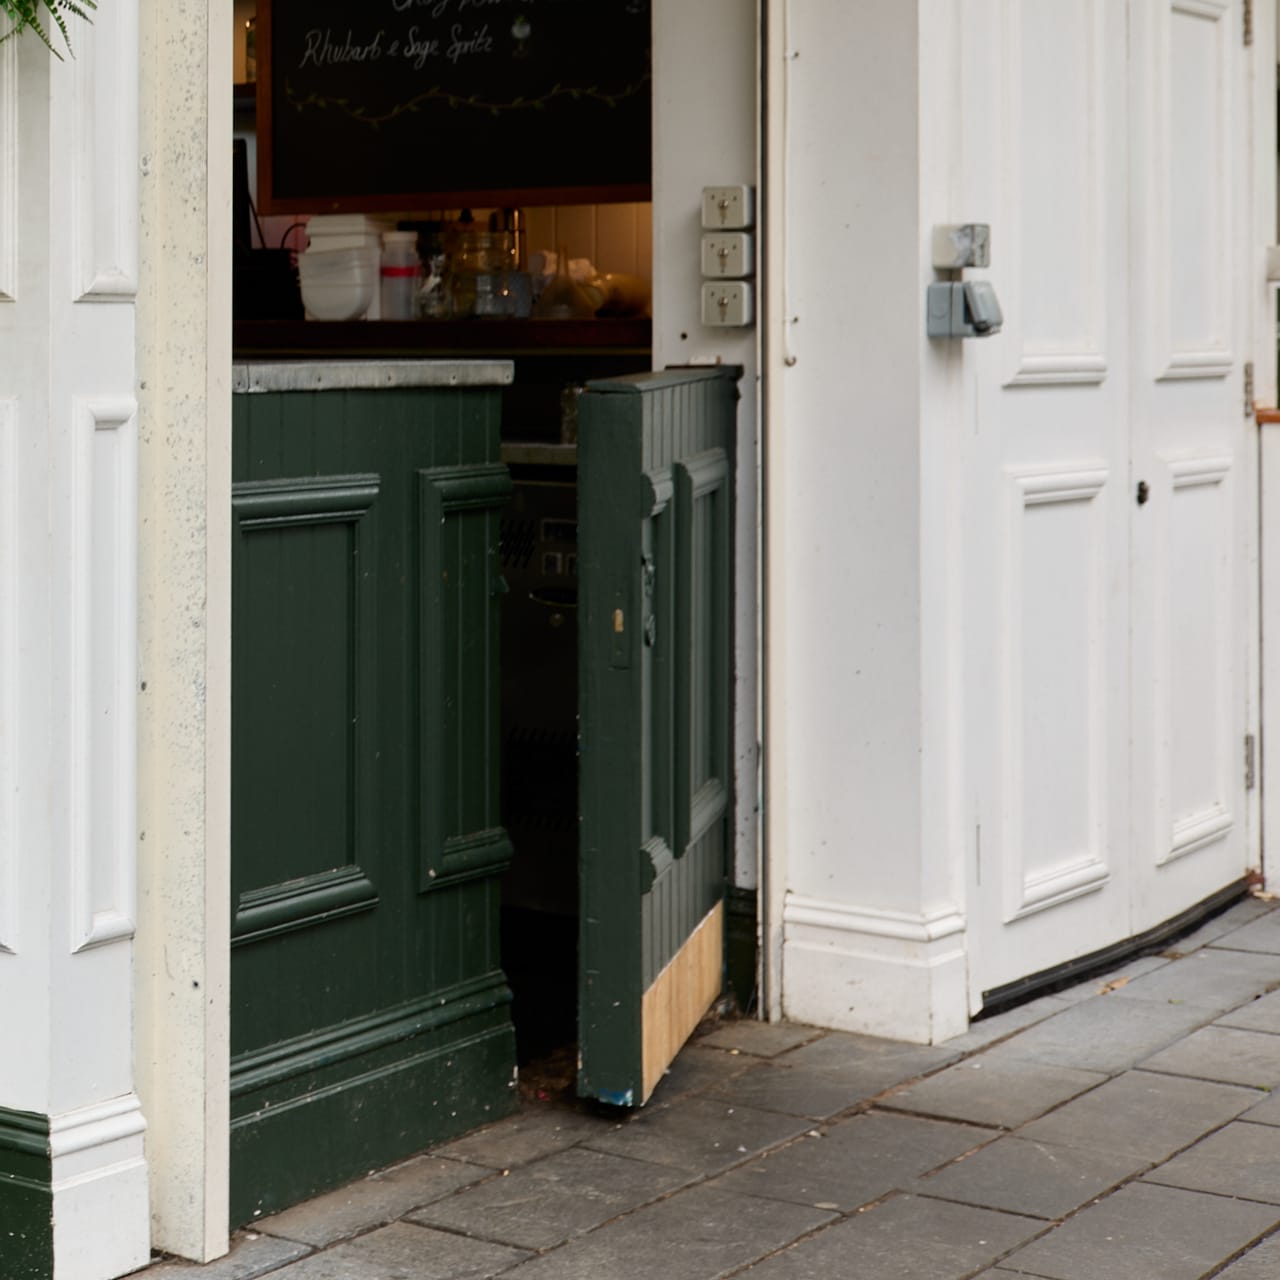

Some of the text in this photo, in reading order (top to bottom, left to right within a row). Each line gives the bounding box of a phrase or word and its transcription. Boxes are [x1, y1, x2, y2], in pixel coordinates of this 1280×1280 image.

[297, 26, 386, 70] Rhubarb
[403, 24, 441, 72] Sage
[445, 23, 496, 65] Spritz
